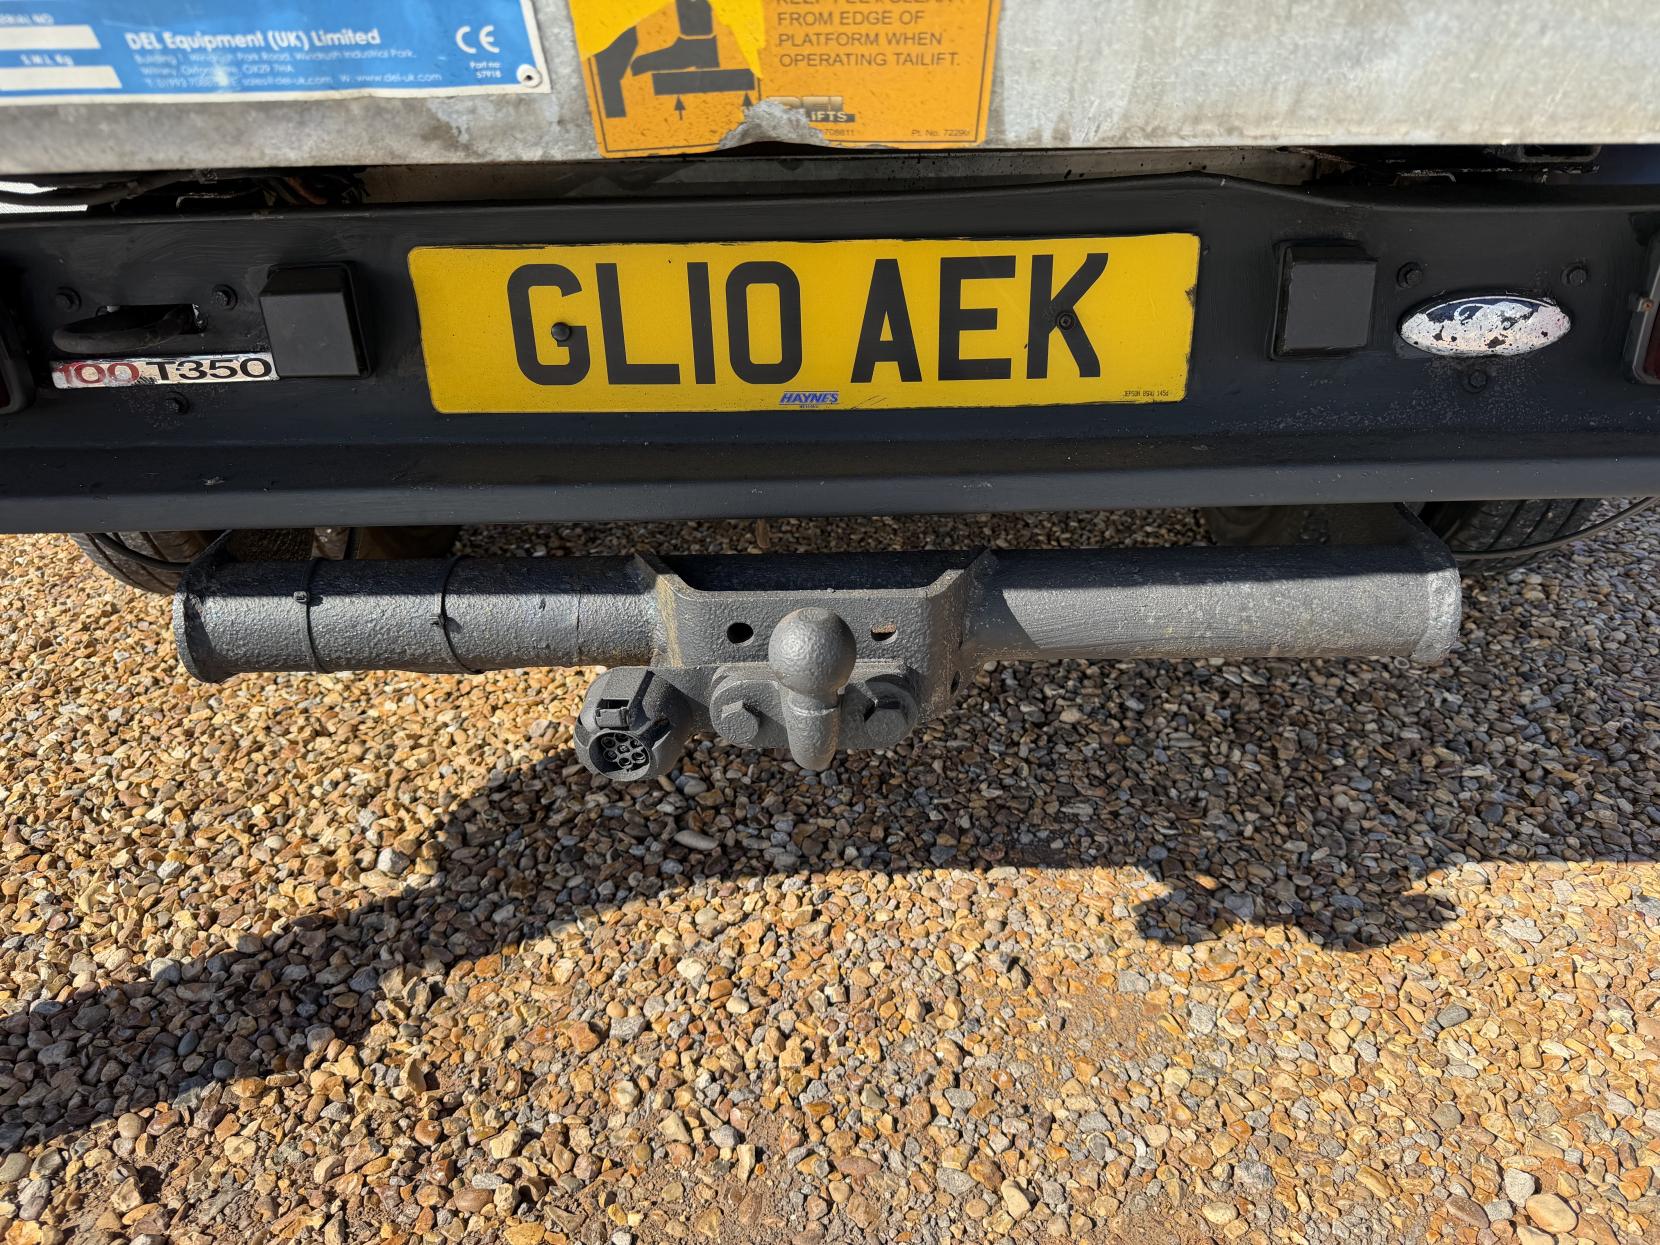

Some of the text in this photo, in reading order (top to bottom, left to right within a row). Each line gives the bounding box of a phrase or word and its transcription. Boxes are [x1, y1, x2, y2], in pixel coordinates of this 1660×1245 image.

[777, 10, 926, 26] FROM EDGE OF
[125, 28, 381, 52] DEL Equipment (UK) Limited
[777, 31, 943, 48] PLATFORM WHEN
[779, 51, 961, 68] OPERATING TAILIFT.
[506, 251, 1110, 387] GL10 AEK
[146, 357, 273, 382] T350
[779, 391, 839, 404] HAYNES
